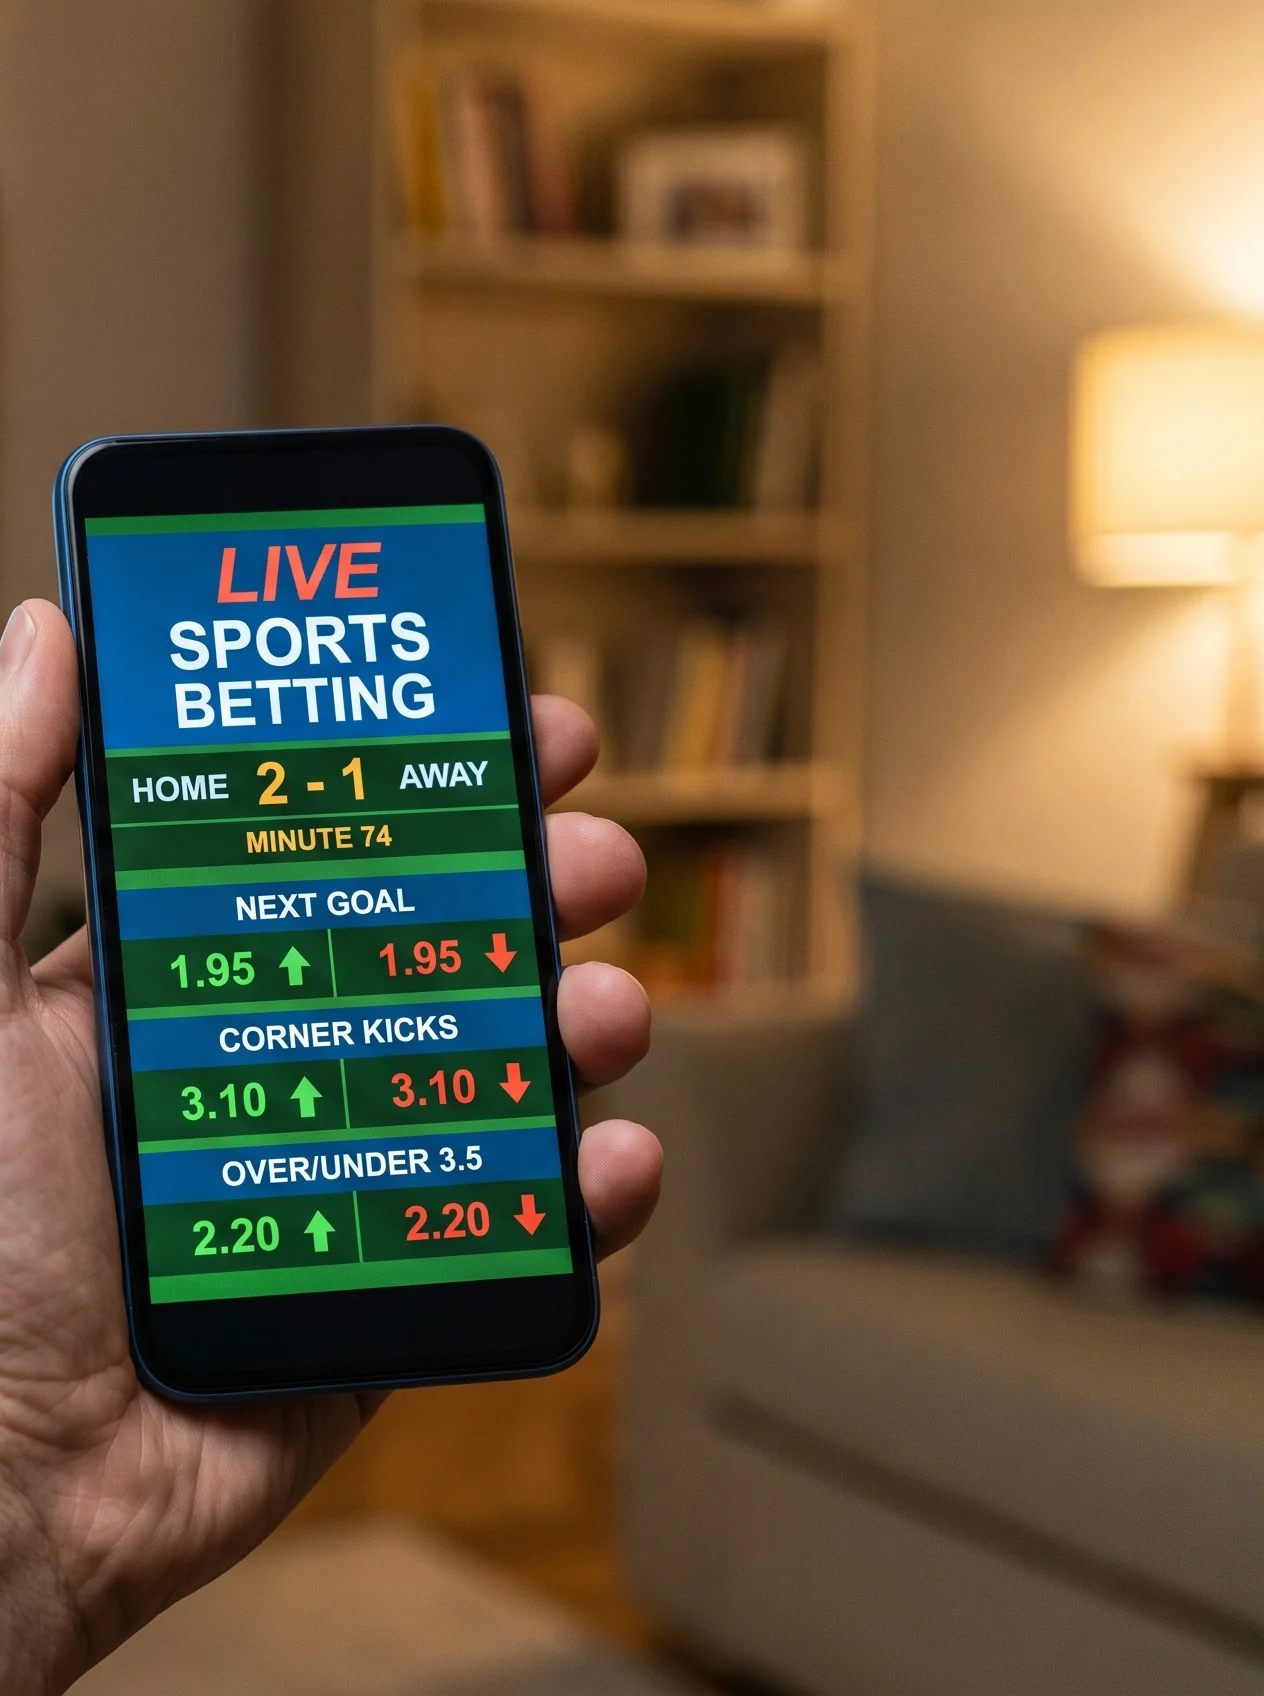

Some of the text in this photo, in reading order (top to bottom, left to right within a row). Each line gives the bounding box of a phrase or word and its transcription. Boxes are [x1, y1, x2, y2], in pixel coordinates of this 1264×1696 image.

[217, 542, 382, 603] LIVE
[169, 611, 430, 671] SPORTS
[174, 672, 435, 729] BETTING
[132, 757, 489, 805] HOME 2 - 1 AWAY
[246, 824, 393, 854] MINUTE 74
[236, 888, 416, 921] NEXT GOAL
[170, 939, 462, 989] 1.95 1.95
[219, 1014, 459, 1053] CORNER KICKS
[181, 1069, 476, 1121] 3.10 3.10
[222, 1145, 483, 1187] OVER/UNDER 3.5
[192, 1201, 490, 1256] 2.20 2.20
